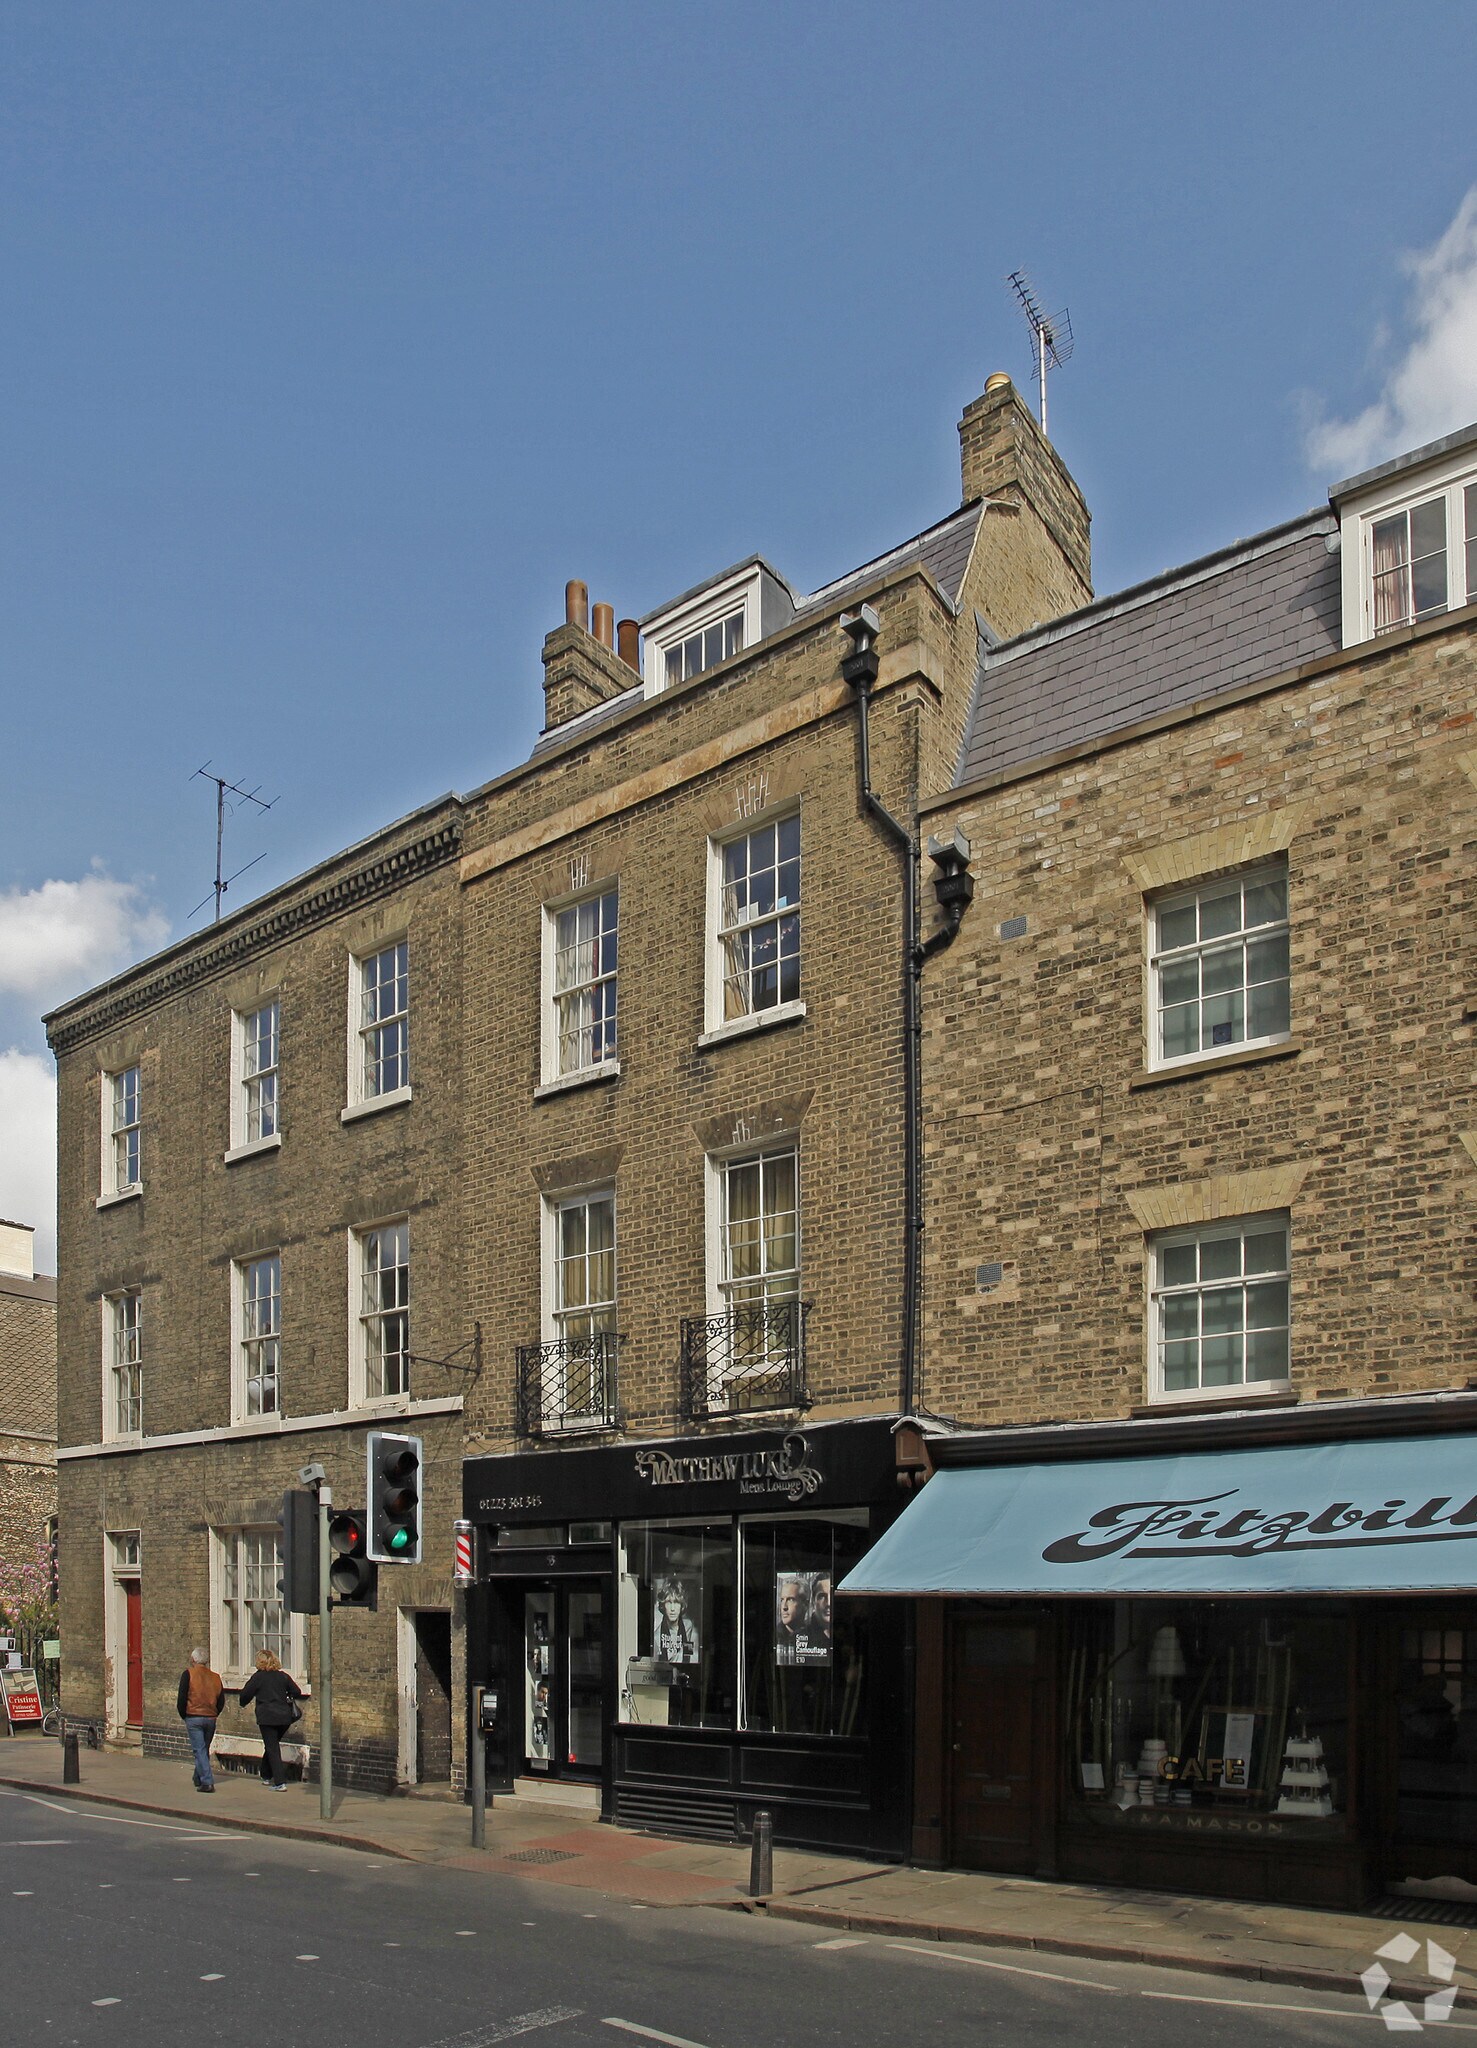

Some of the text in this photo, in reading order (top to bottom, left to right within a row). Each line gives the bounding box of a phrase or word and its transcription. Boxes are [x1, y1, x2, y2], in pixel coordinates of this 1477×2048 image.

[650, 1450, 792, 1485] MATTHEW LUKE
[739, 1478, 802, 1494] Mens Lounge
[479, 1498, 506, 1510] 01223
[796, 1646, 827, 1655] Camouflage
[8, 1696, 37, 1704] Cristine
[1157, 1755, 1245, 1785] CAFE
[1186, 1815, 1283, 1834] MASON
